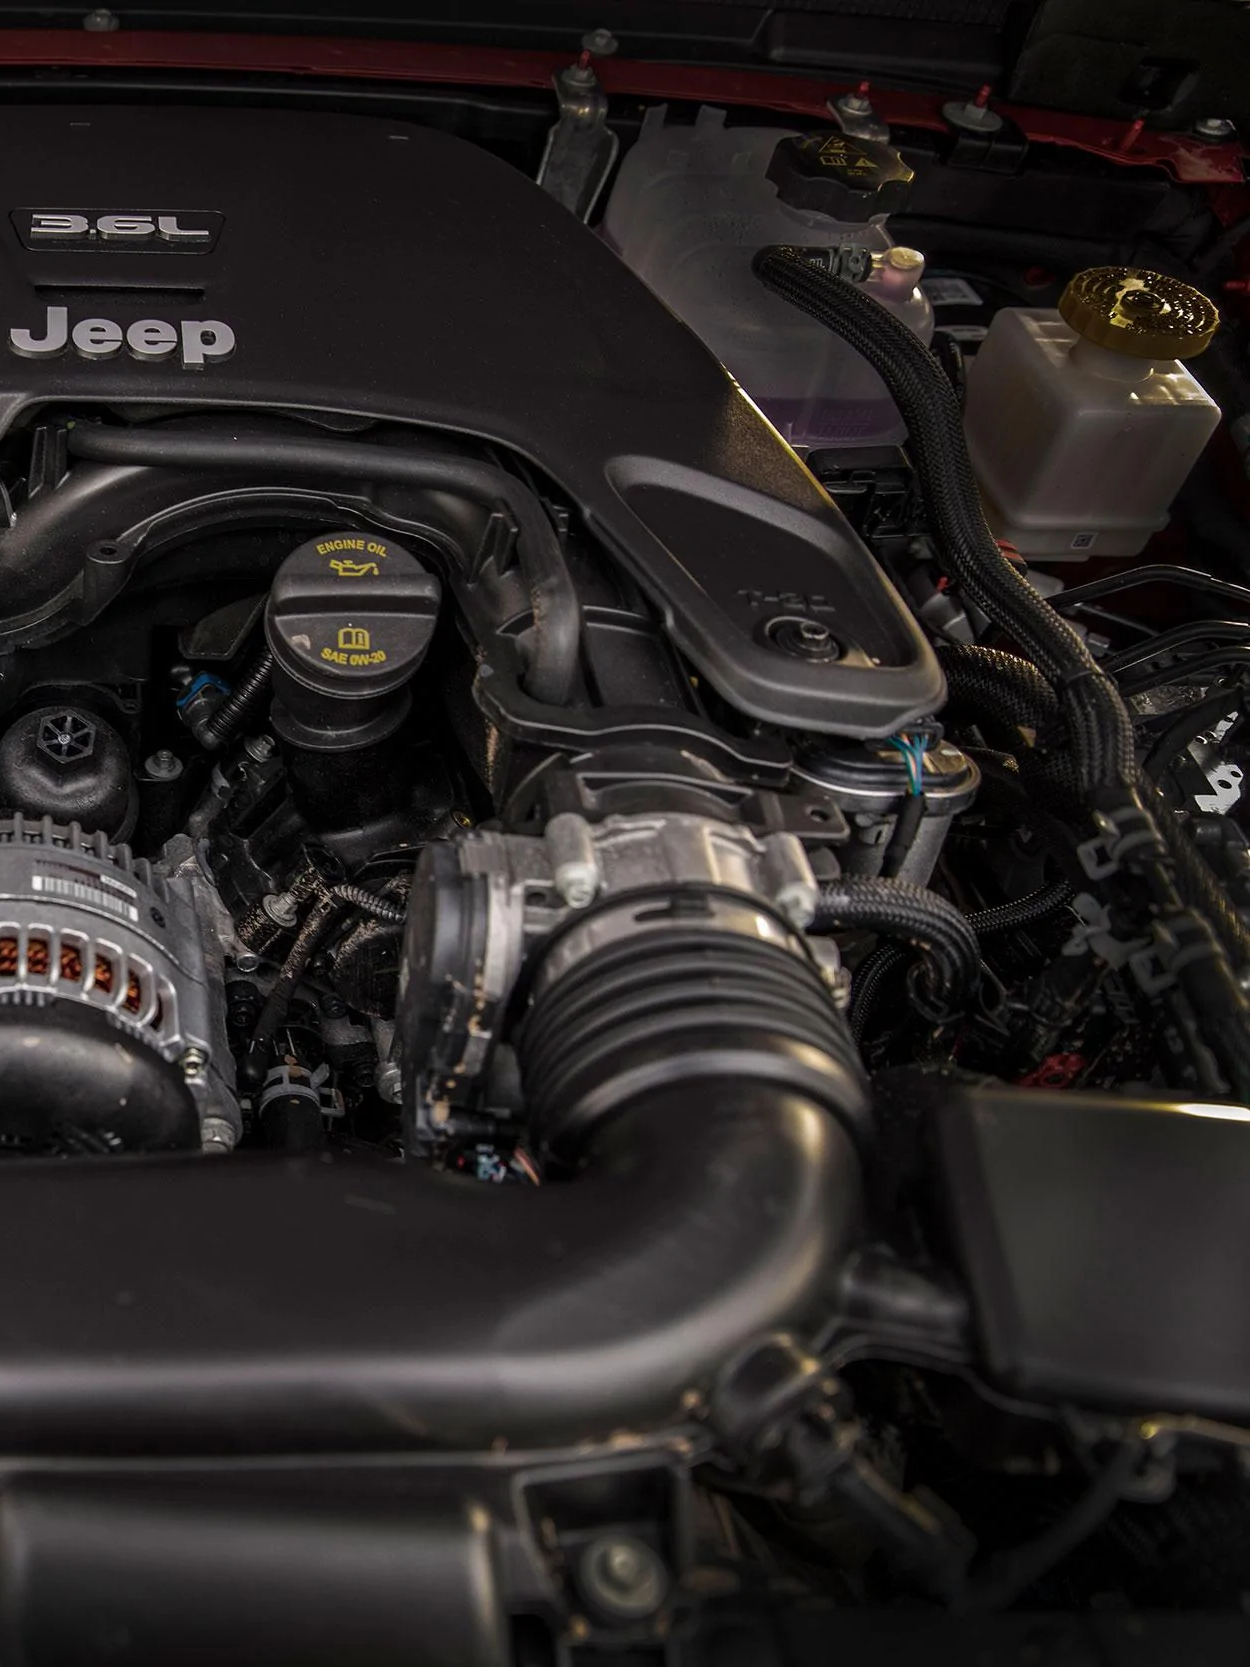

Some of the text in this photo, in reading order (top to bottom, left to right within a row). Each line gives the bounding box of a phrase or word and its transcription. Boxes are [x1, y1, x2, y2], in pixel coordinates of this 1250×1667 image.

[30, 214, 210, 242] 3.6L
[9, 306, 237, 369] Jeep
[316, 539, 387, 558] ENGINE OIL
[320, 647, 387, 667] SAE 0W-20
